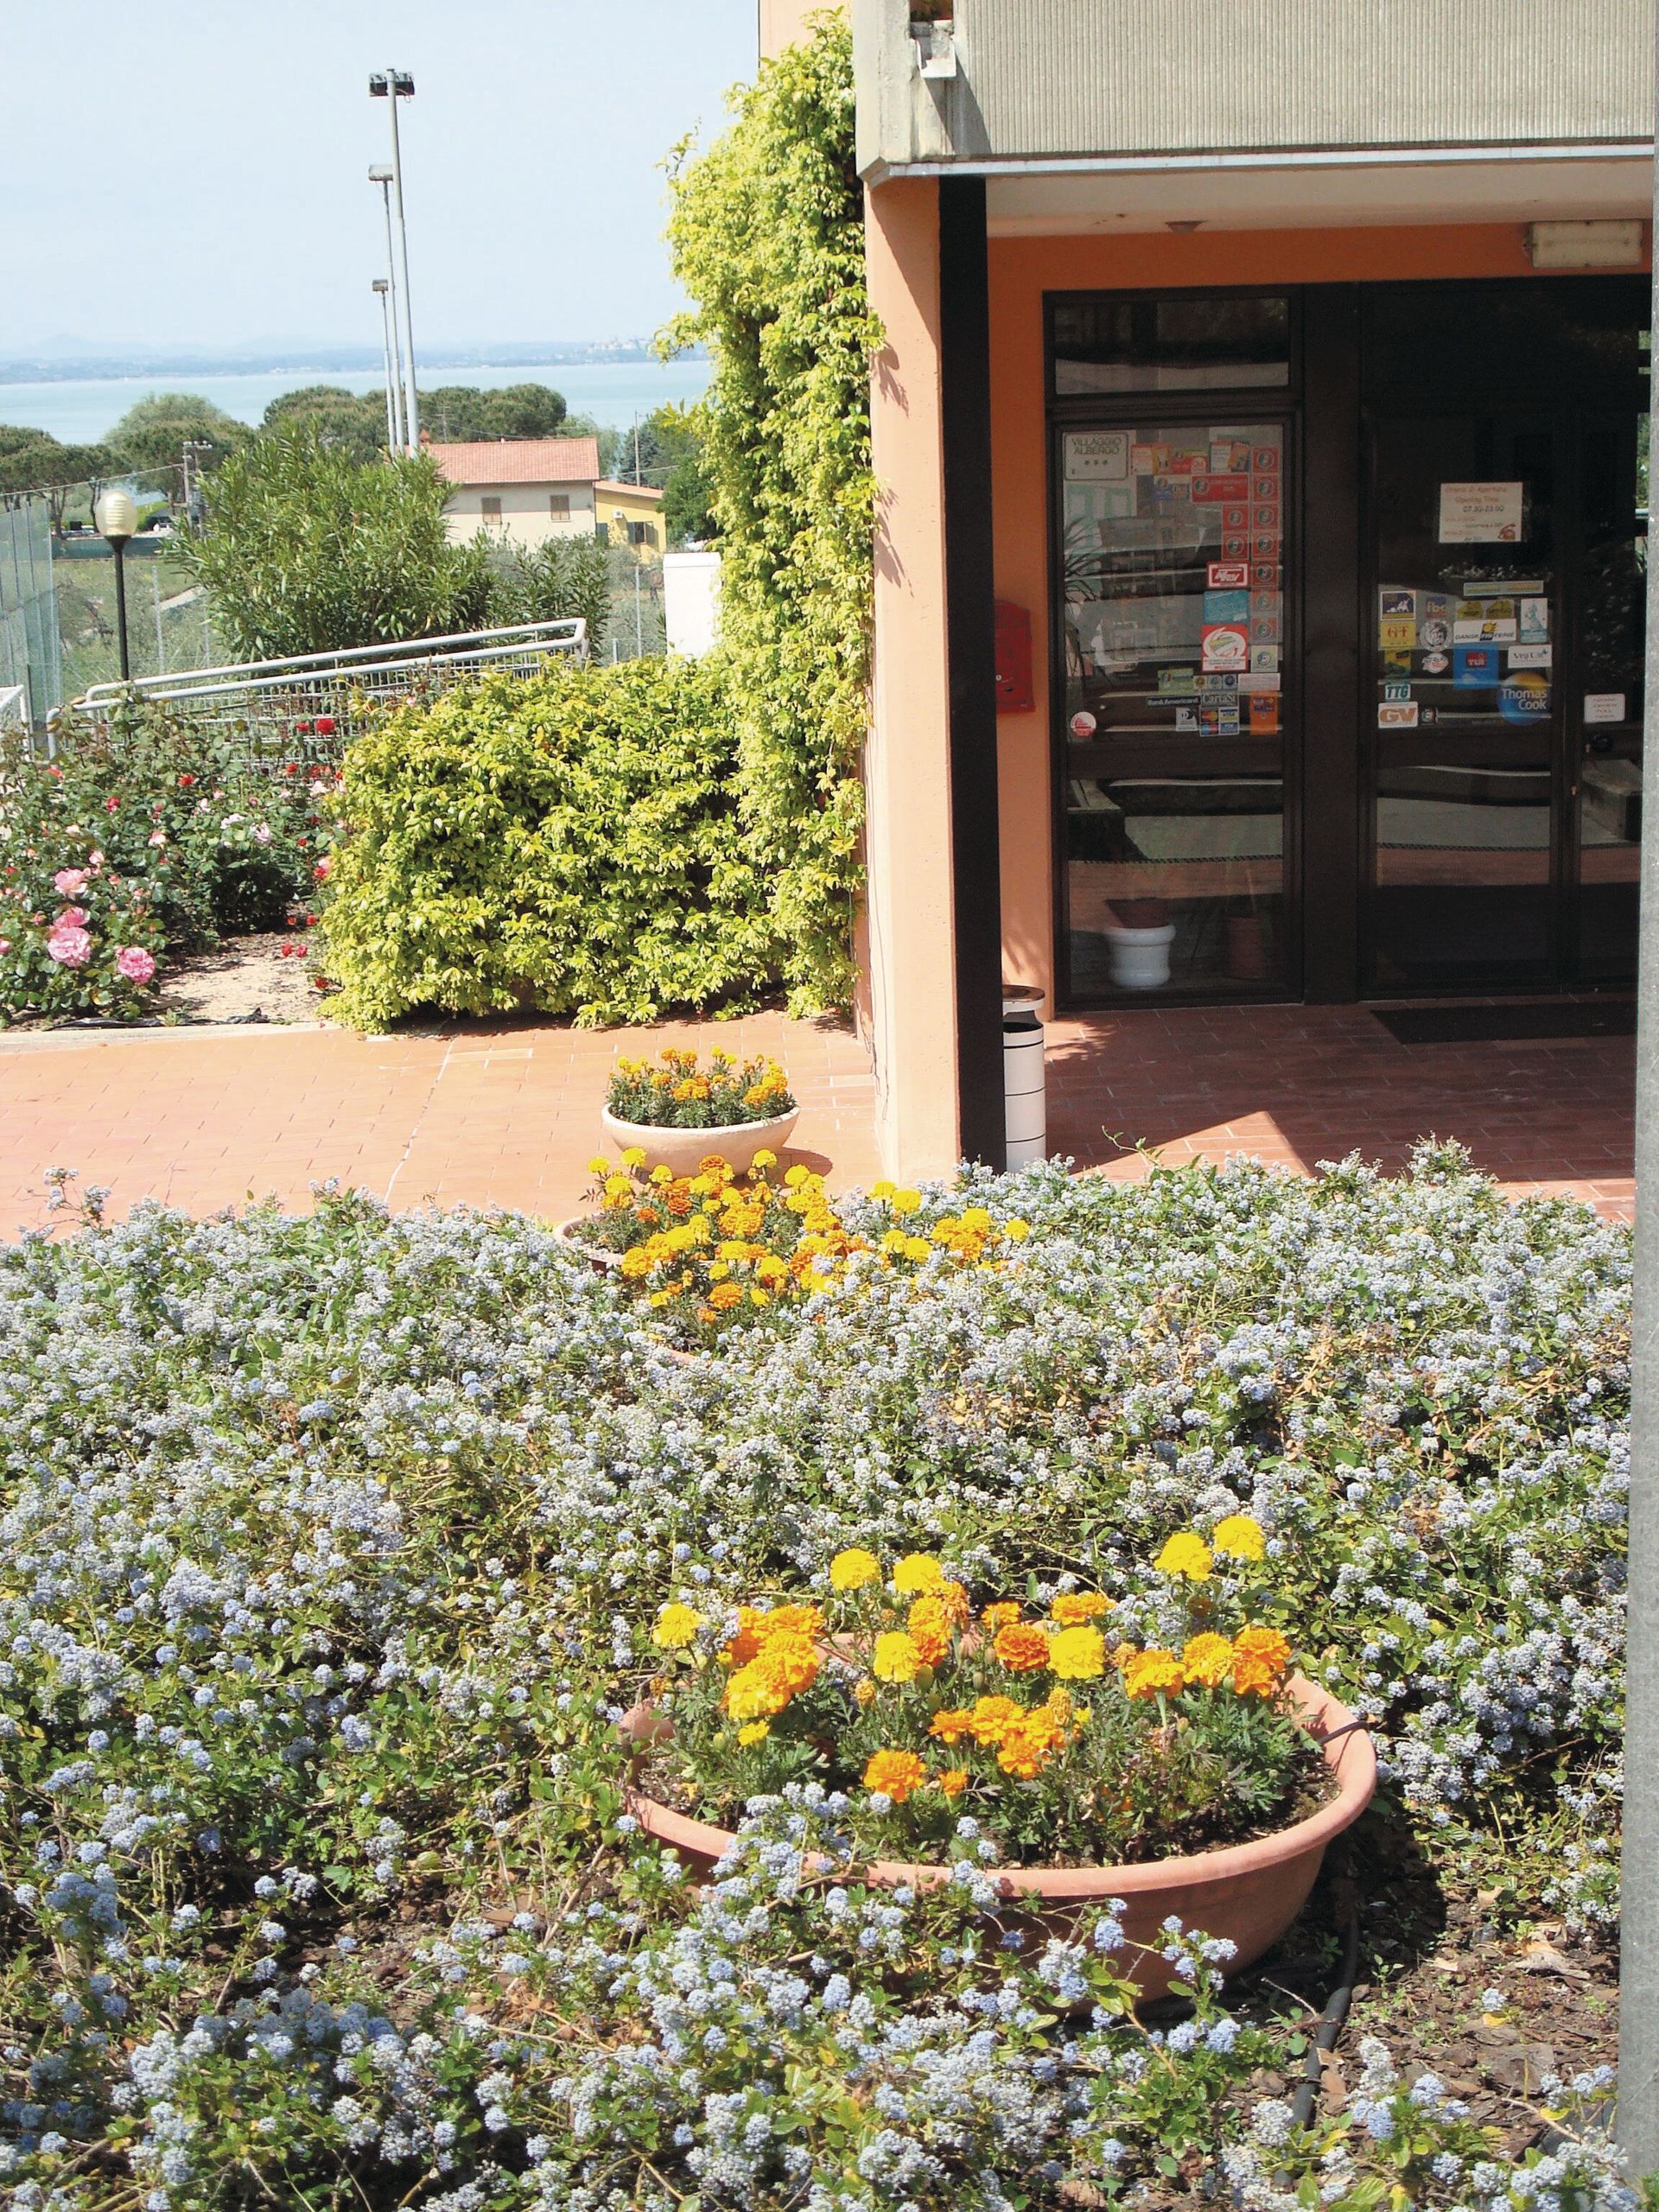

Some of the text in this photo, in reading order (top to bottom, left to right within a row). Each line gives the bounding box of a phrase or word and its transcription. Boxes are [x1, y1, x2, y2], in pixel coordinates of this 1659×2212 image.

[1071, 437, 1122, 446] VILLAGGIO
[1386, 686, 1410, 699] TTG
[1502, 689, 1548, 699] Thomas
[1518, 699, 1547, 709] Cook
[1379, 707, 1416, 723] GV
